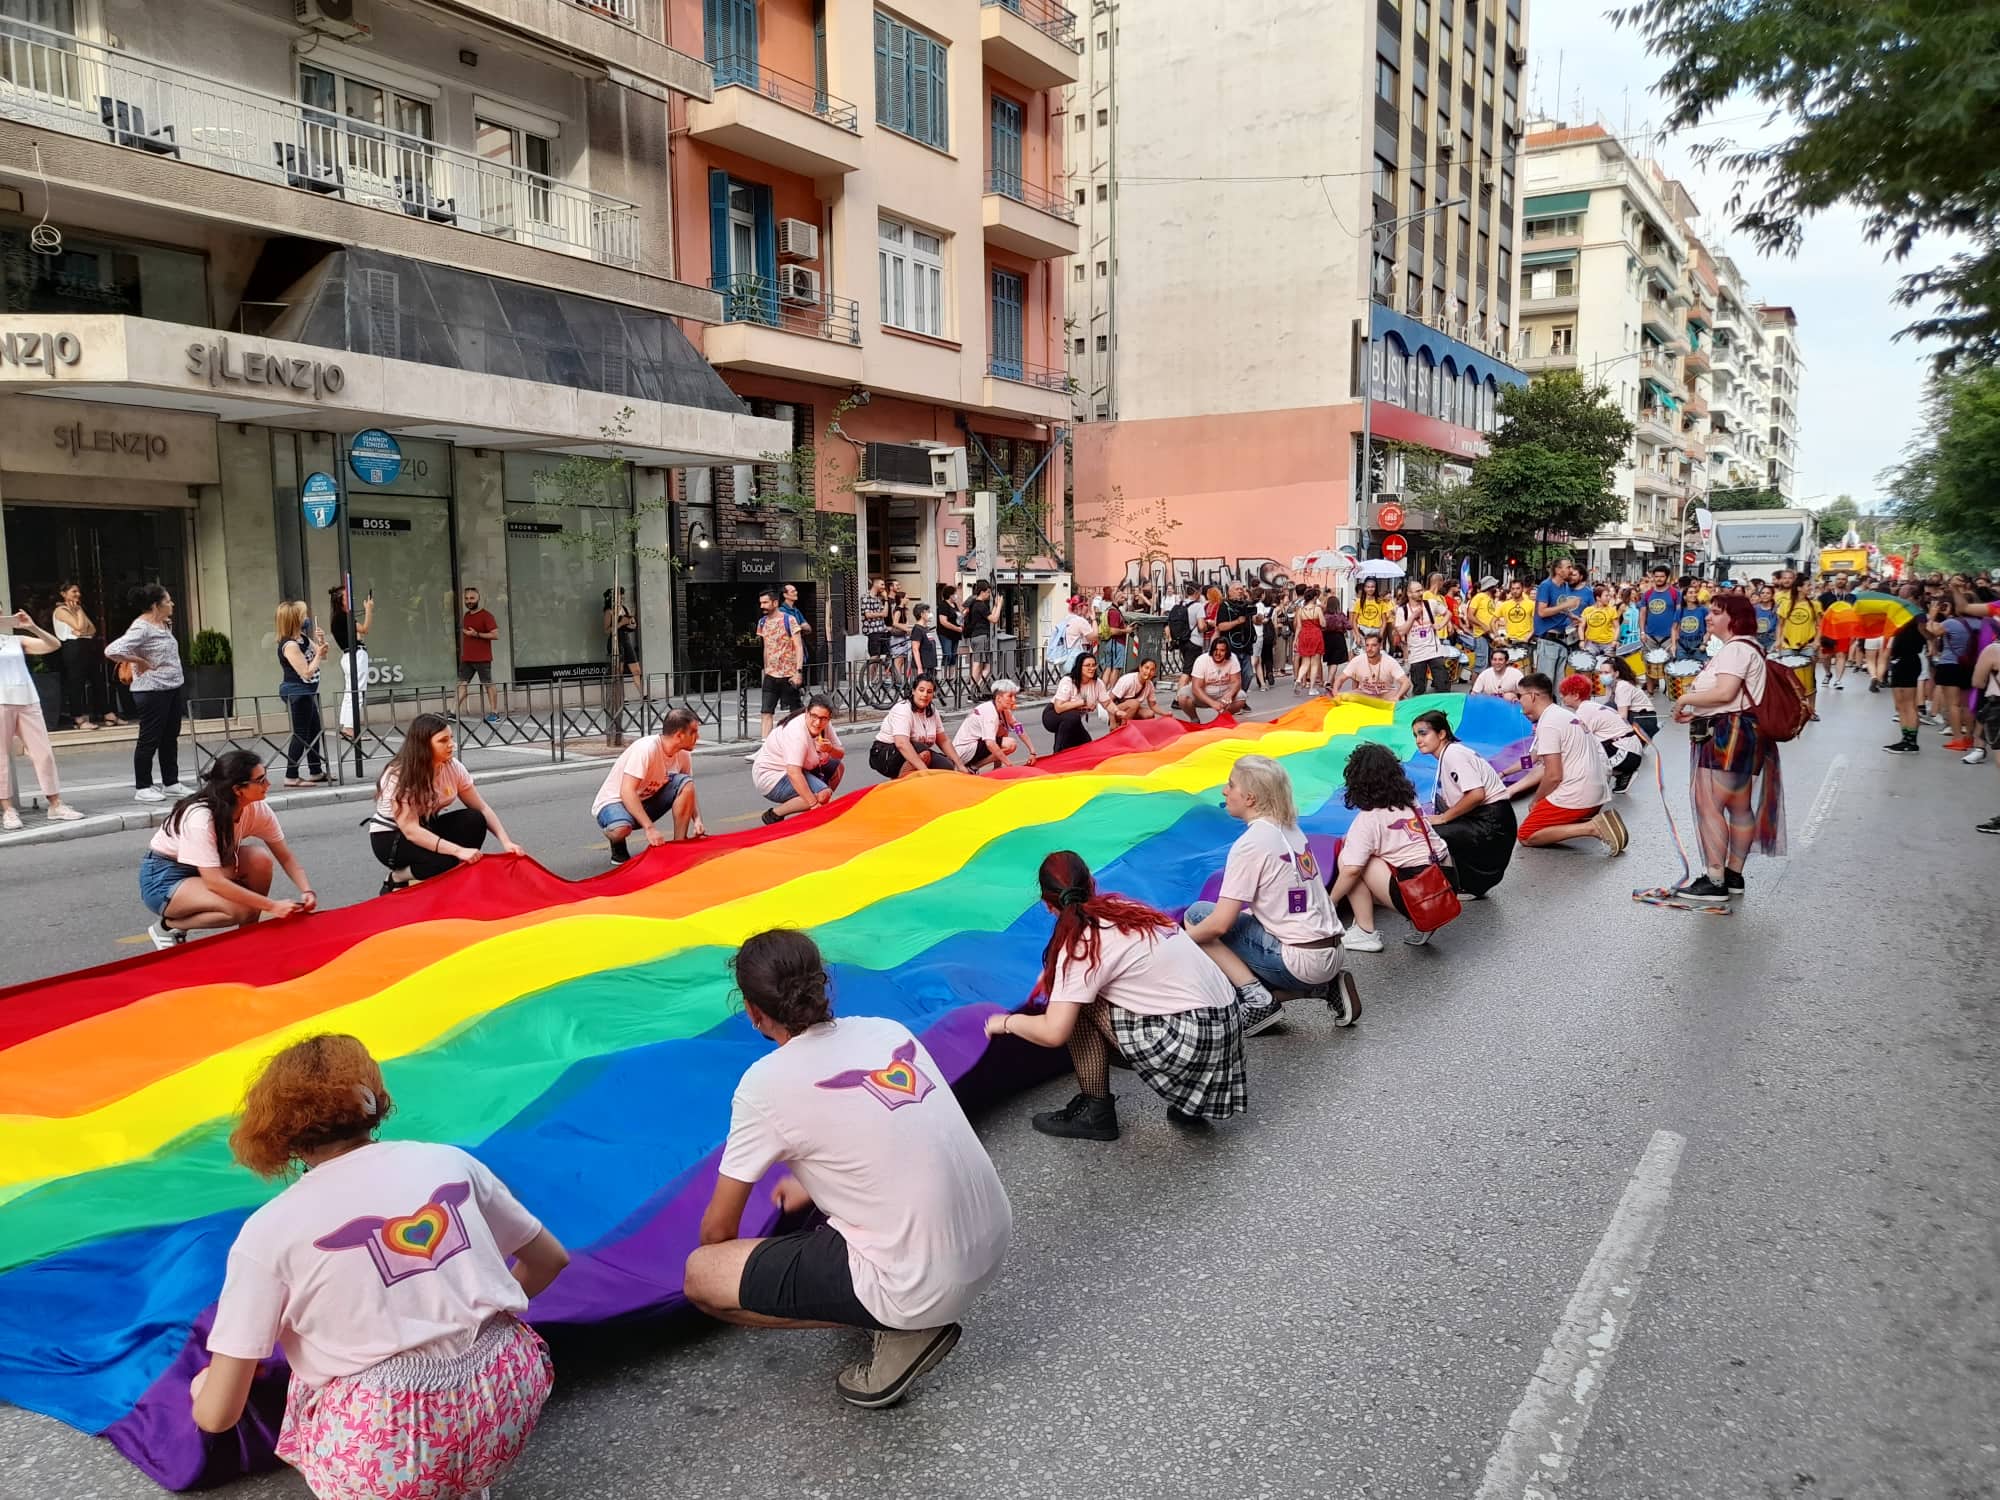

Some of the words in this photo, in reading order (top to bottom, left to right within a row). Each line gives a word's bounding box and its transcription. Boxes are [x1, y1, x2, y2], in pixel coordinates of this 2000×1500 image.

[185, 335, 345, 400] SILENZIO
[54, 421, 168, 463] SILENZIO
[362, 518, 391, 529] BOSS
[366, 664, 405, 685] OSS
